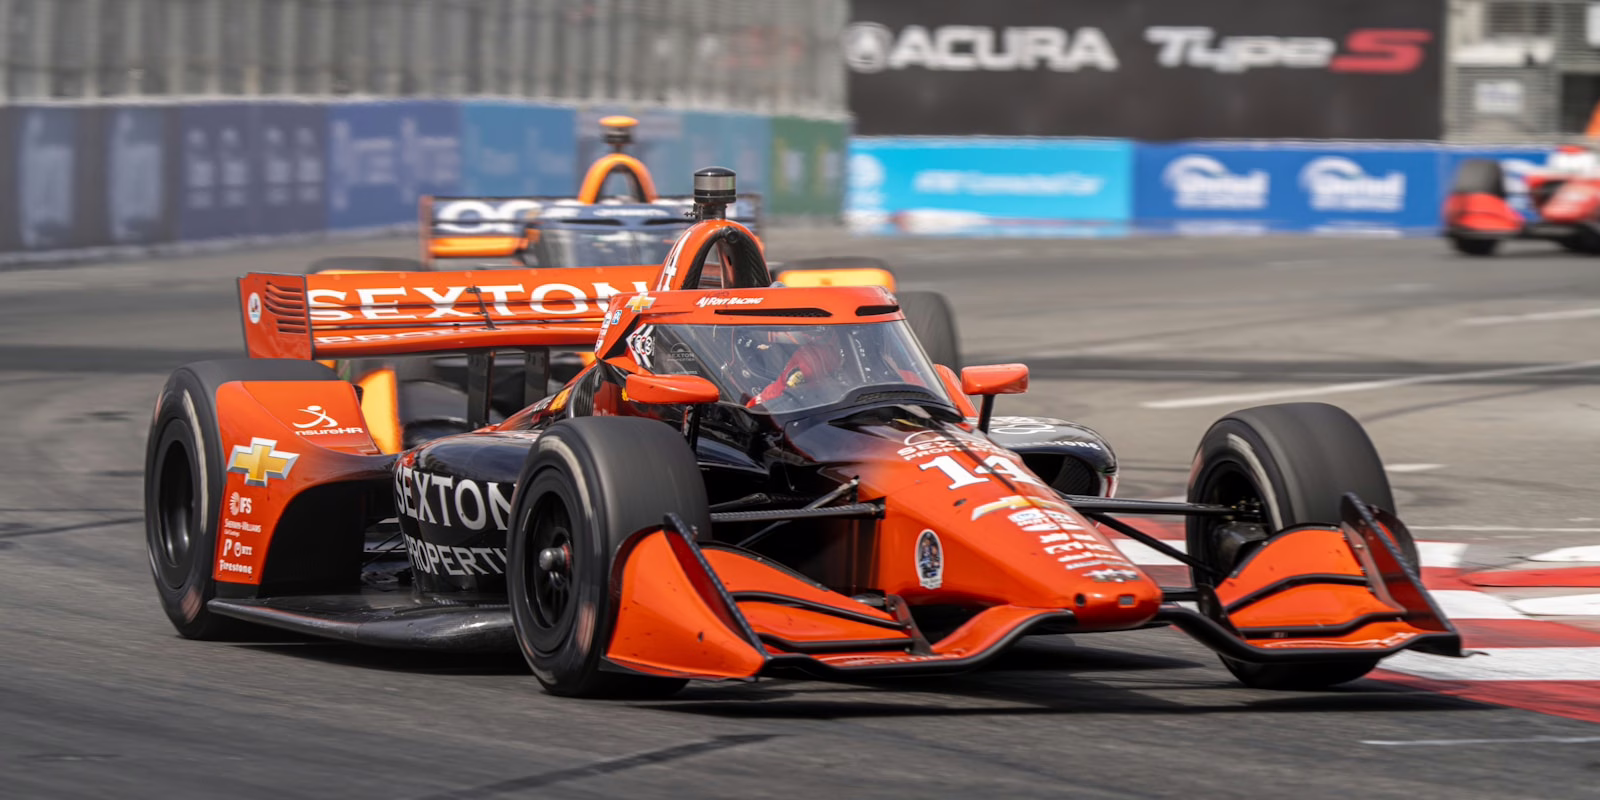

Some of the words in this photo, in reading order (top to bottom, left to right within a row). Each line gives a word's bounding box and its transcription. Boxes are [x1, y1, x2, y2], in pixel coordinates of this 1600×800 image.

[889, 25, 1119, 72] ACURA
[1329, 29, 1433, 73] S
[307, 282, 648, 321] SEXTON
[918, 455, 1045, 490] 14
[396, 463, 516, 530] SEXTON
